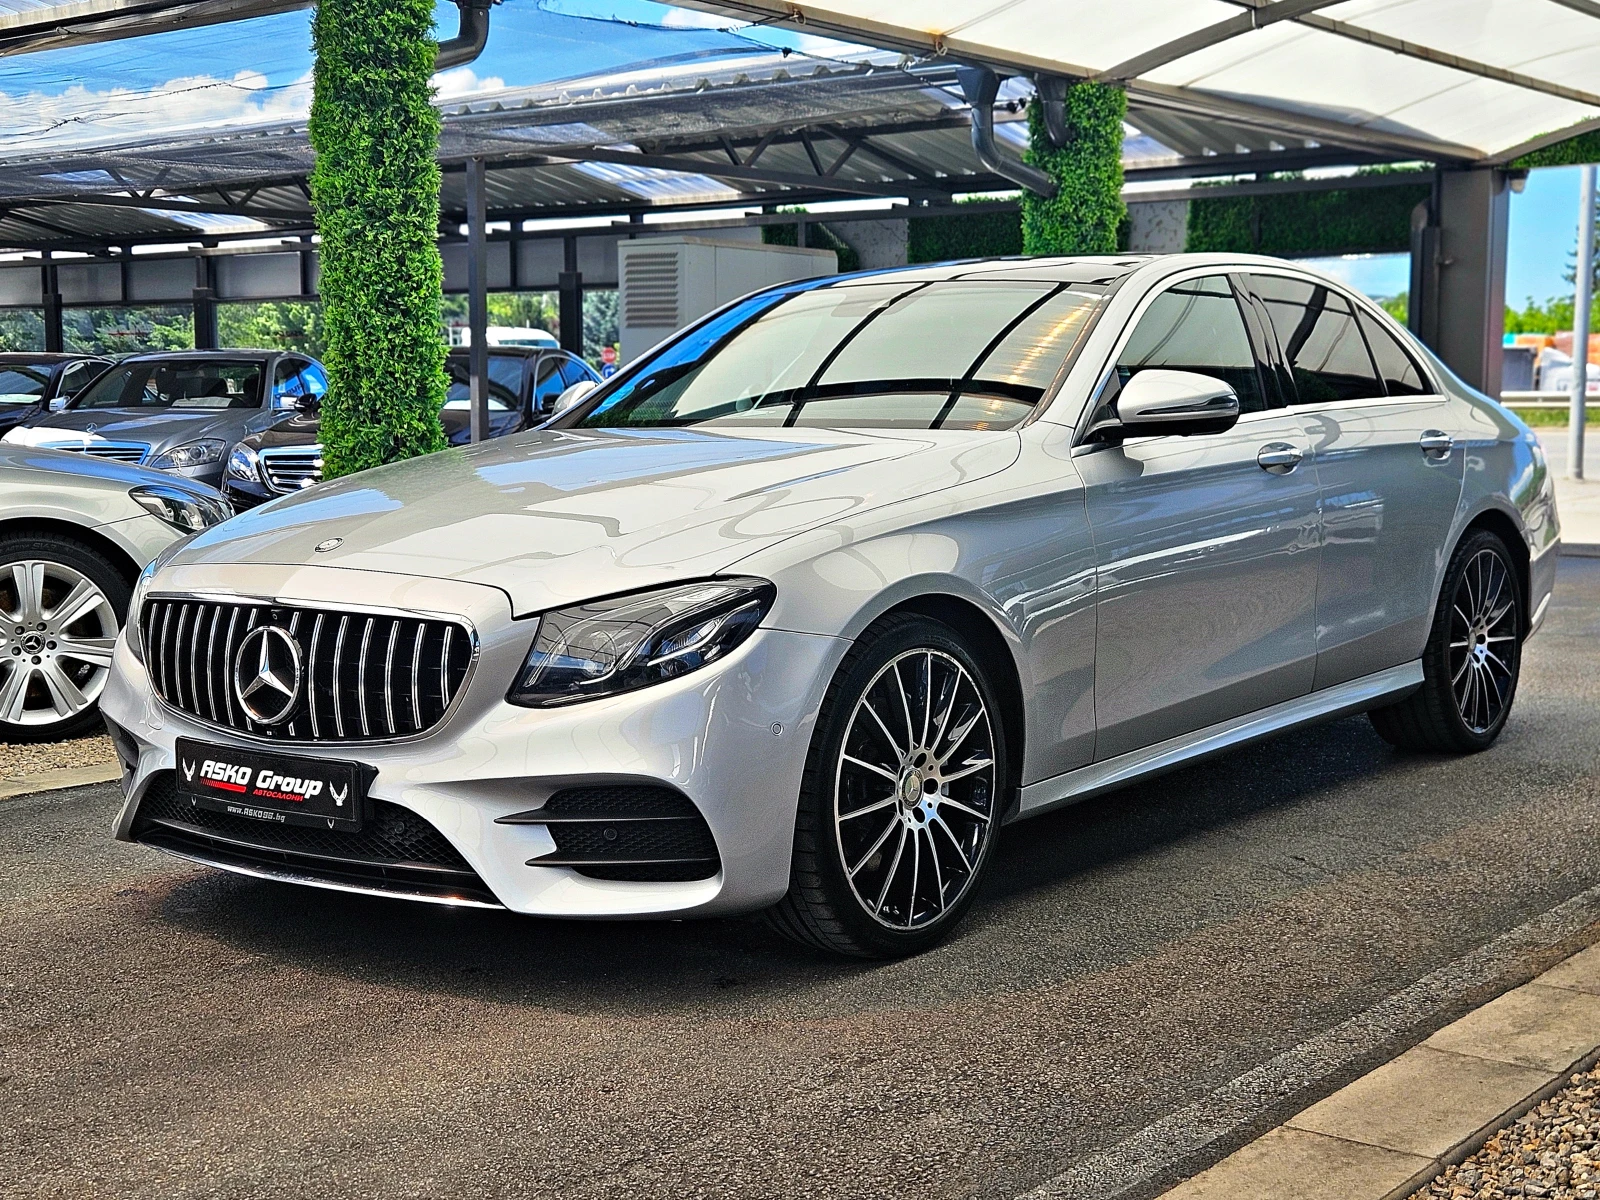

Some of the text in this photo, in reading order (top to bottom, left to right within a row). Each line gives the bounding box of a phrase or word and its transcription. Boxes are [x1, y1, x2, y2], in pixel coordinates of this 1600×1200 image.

[200, 760, 323, 799] ASKO Group
[253, 789, 303, 801] АВТОСАЛОНИ
